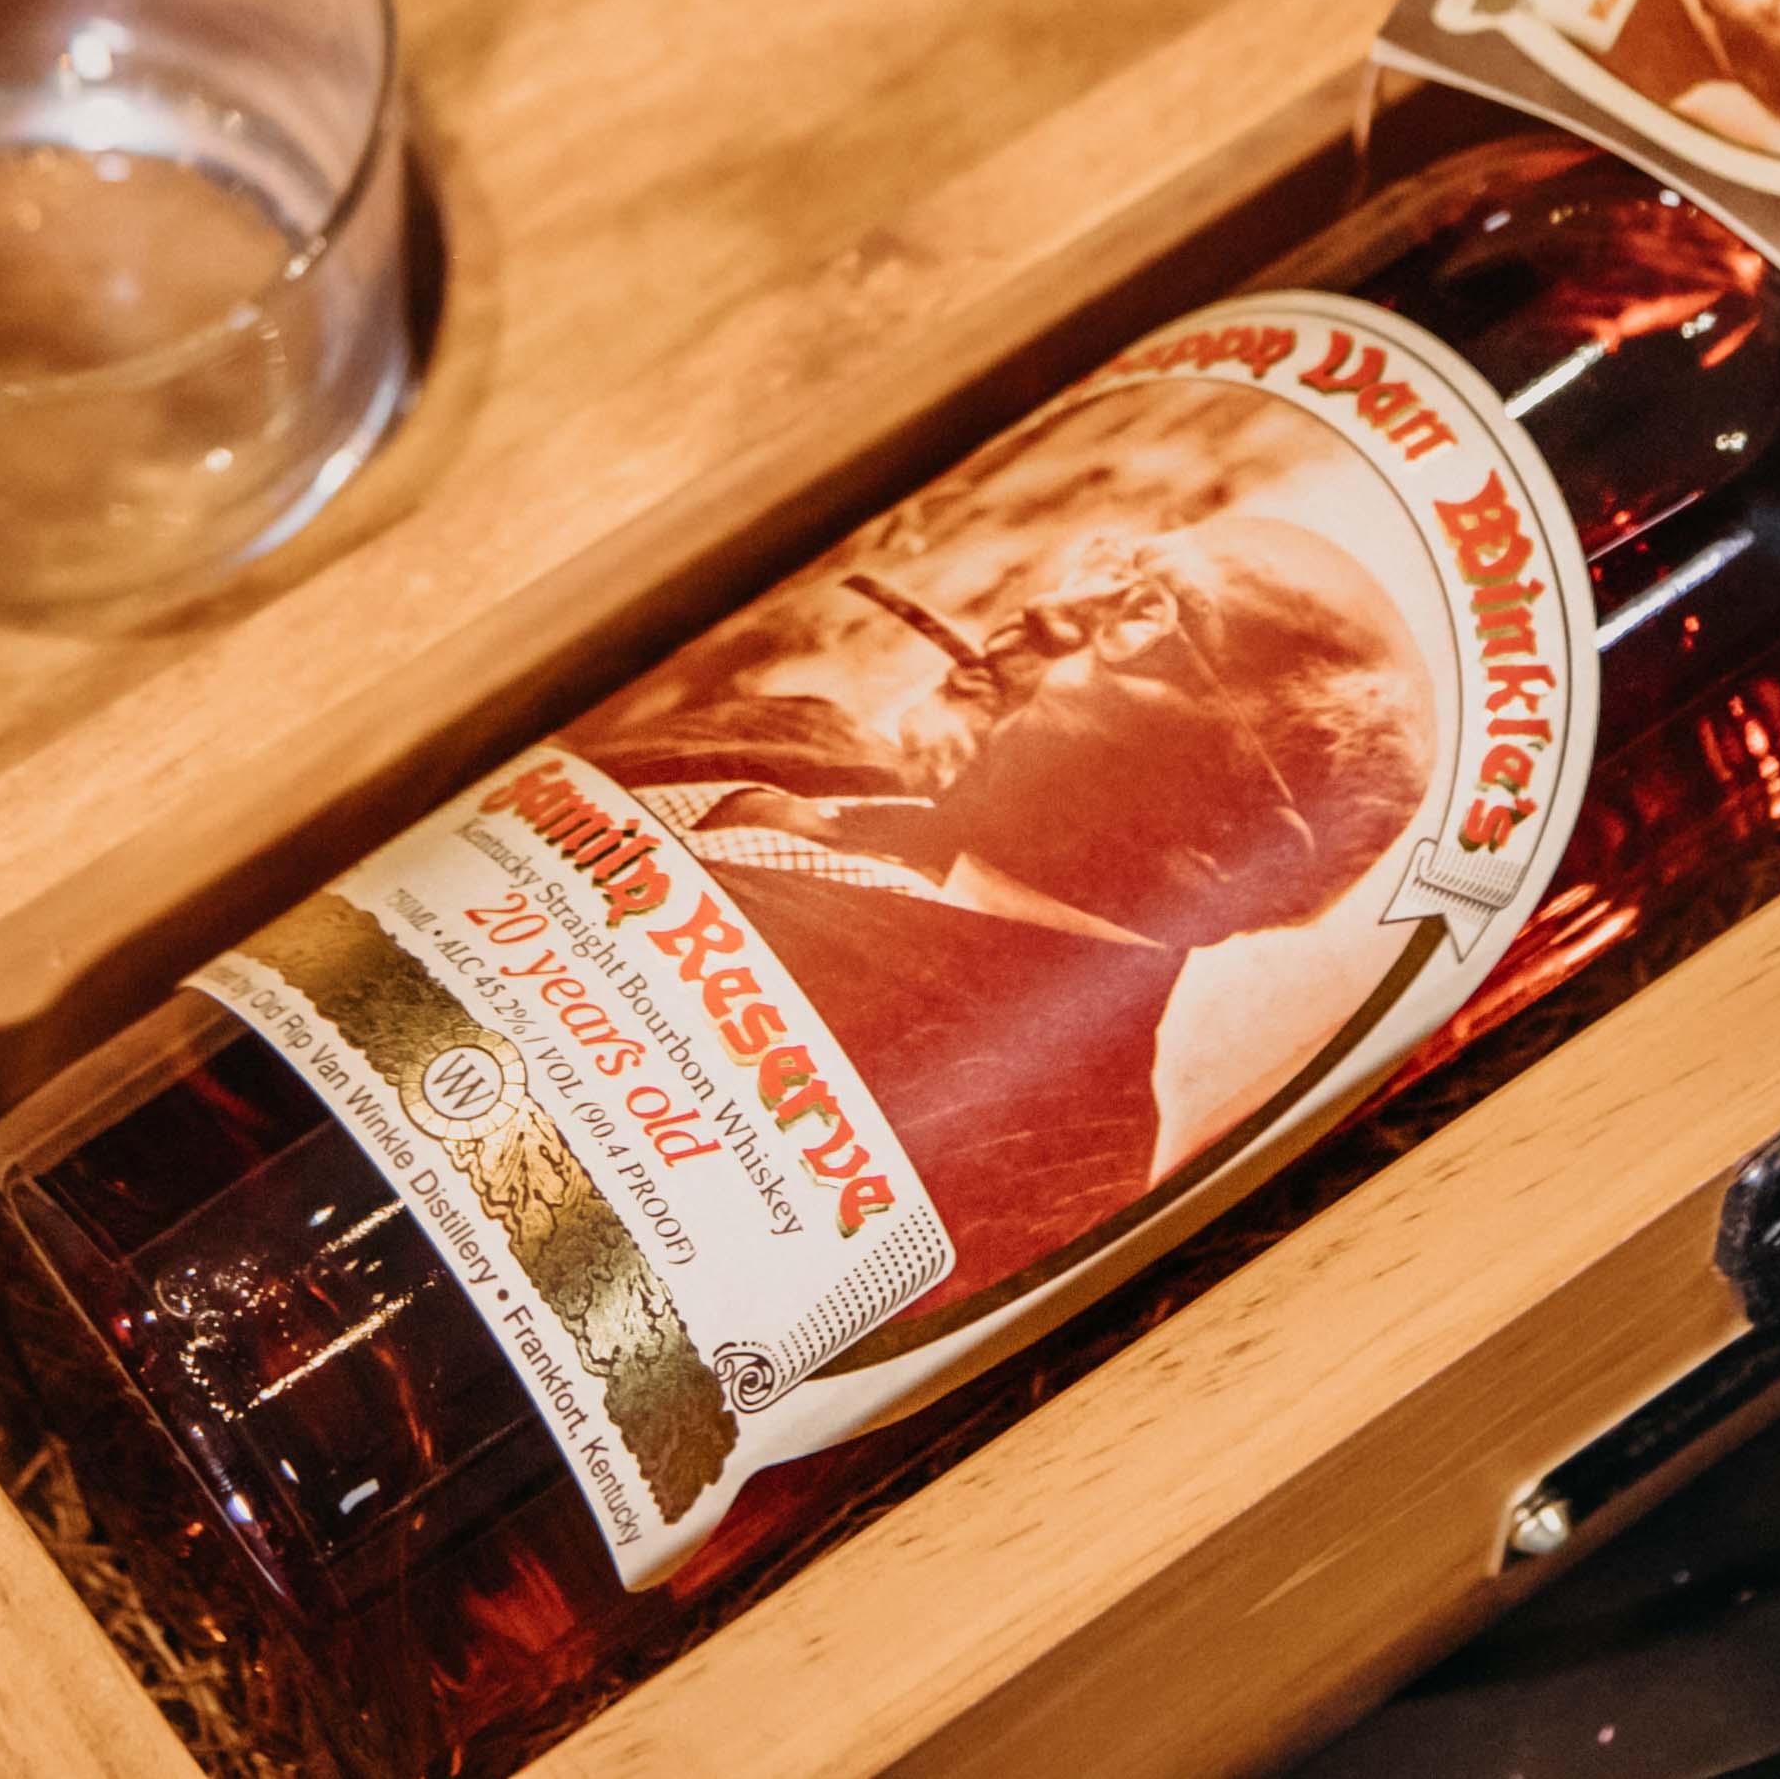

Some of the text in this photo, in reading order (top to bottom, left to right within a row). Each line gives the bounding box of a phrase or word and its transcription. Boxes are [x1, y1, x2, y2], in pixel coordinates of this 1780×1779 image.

[1299, 329, 1460, 464] Van
[1433, 469, 1558, 855] Winkle's
[433, 940, 486, 975] ALC
[536, 1045, 584, 1099] VOL
[570, 1101, 631, 1160] (90.4
[616, 1160, 698, 1266] PROOF)
[454, 817, 804, 1237] Kentucky Straight Bourbon Whiskey
[464, 892, 723, 1169] 20 years old
[477, 759, 897, 1240] Family Reserve
[249, 989, 287, 1021] Old
[281, 1013, 313, 1050] Rip
[309, 1043, 351, 1091] Van
[345, 1084, 416, 1170] Winkle
[408, 1167, 500, 1287] Distillery
[502, 1303, 589, 1441] Frankfort,
[579, 1438, 643, 1547] Kentucky
